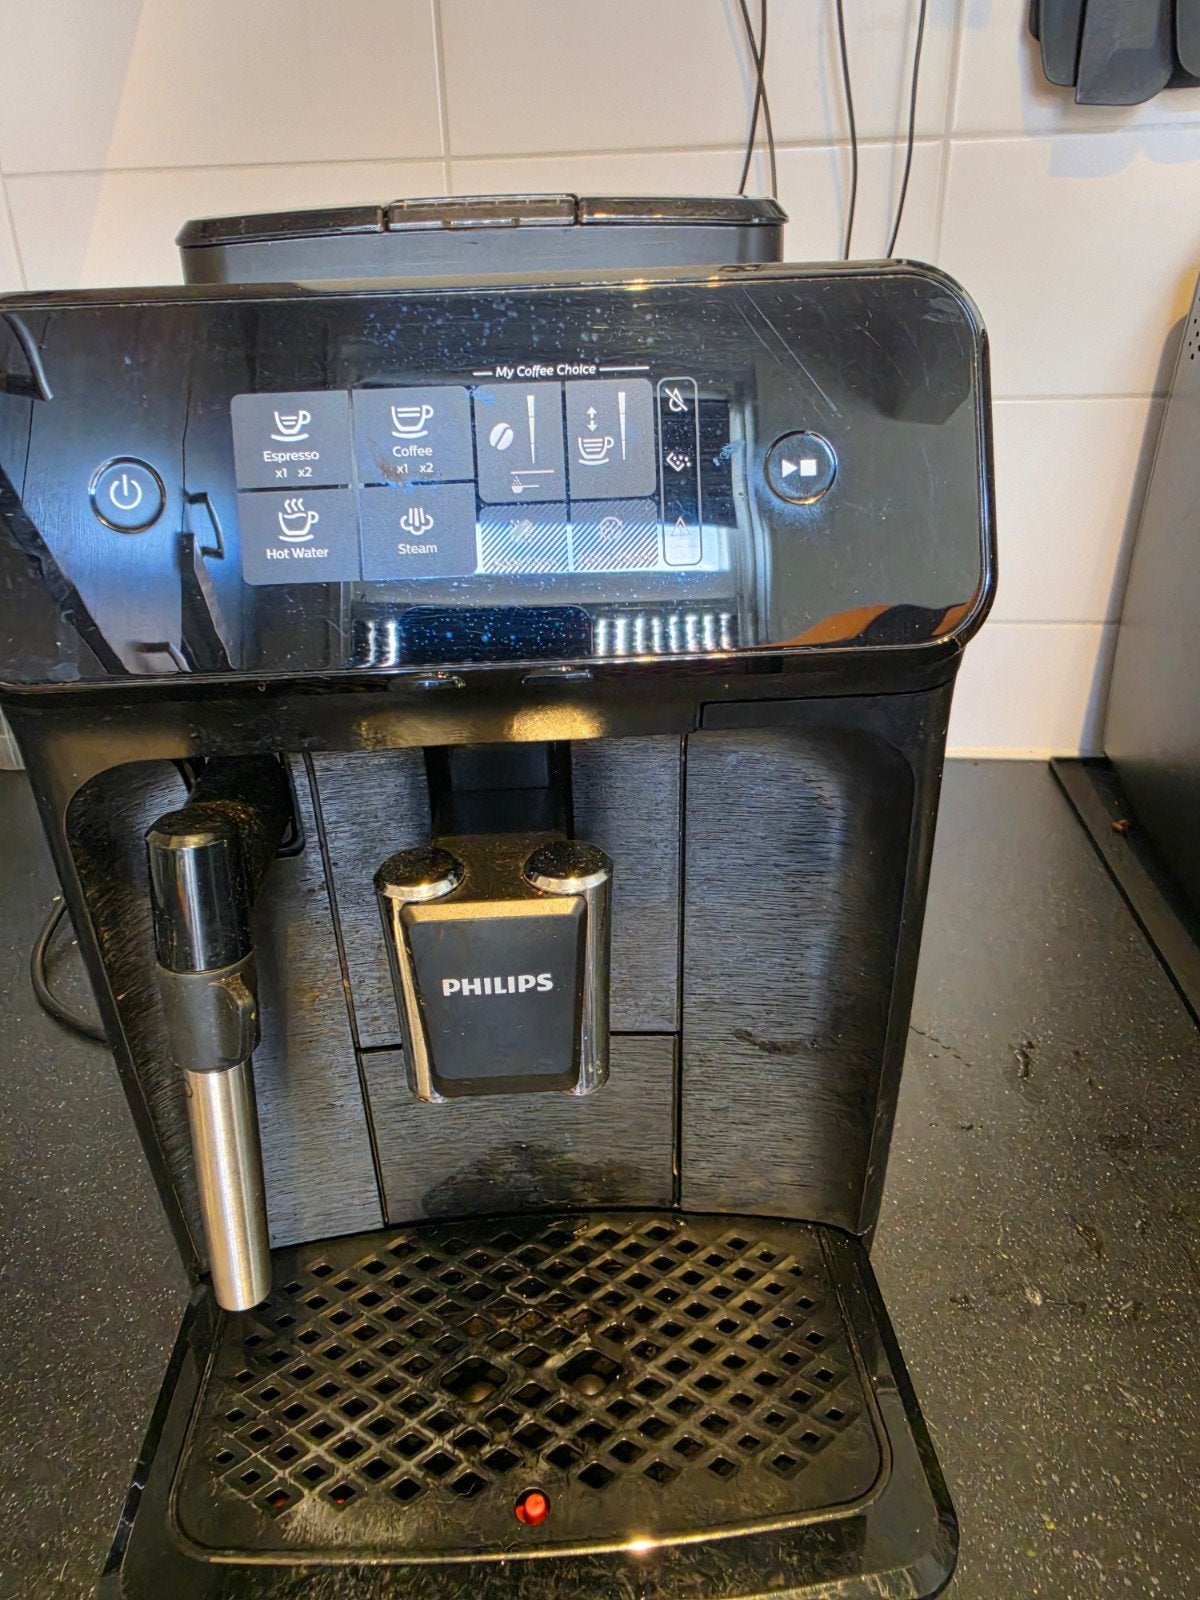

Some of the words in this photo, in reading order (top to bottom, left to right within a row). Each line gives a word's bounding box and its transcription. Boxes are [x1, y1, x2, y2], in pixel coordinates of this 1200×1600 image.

[495, 366, 514, 379] My
[516, 365, 554, 378] Coffee
[556, 363, 596, 376] Choice
[263, 450, 320, 463] Espresso
[392, 445, 433, 457] Coffee
[275, 468, 288, 479] x1
[297, 466, 312, 478] x2
[396, 463, 409, 474] x1
[419, 462, 434, 473] x2
[266, 548, 290, 560] Hot
[291, 546, 329, 559] Water
[397, 543, 438, 555] Steam
[442, 973, 554, 997] PHILIPS
